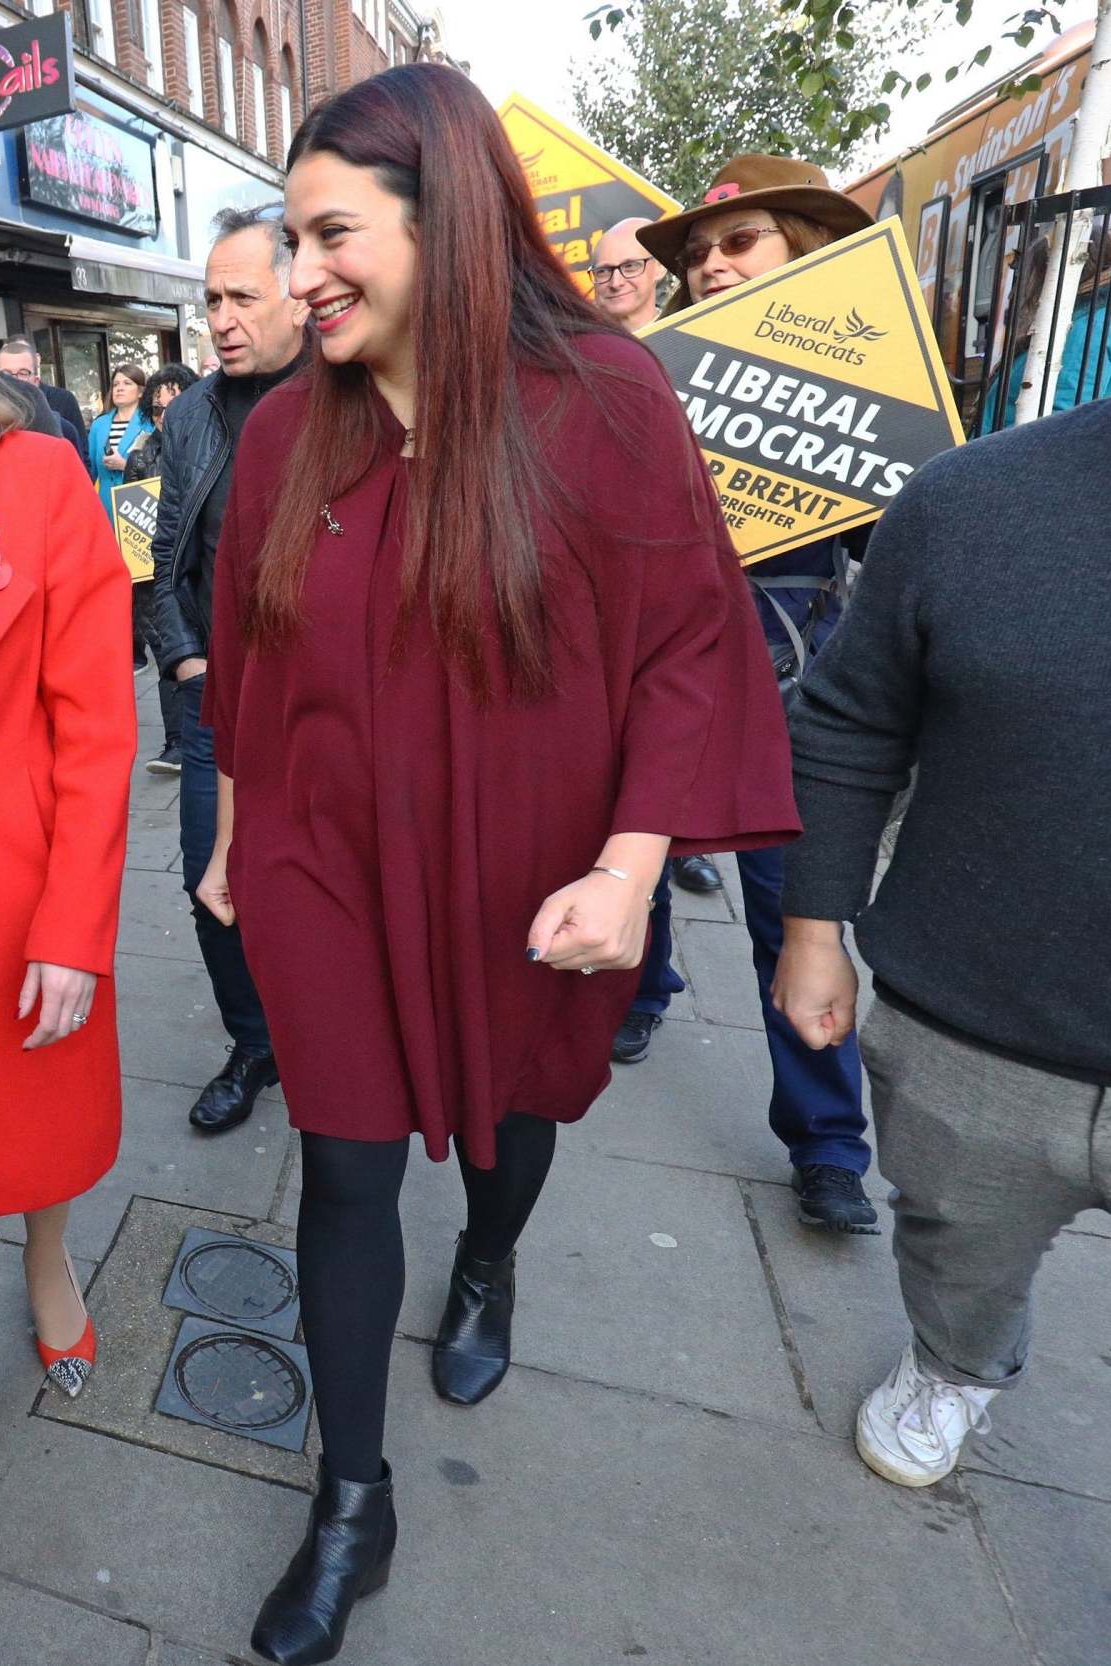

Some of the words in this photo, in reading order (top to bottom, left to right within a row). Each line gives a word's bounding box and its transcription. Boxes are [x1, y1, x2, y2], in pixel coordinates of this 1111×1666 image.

[537, 194, 582, 234] al
[764, 301, 836, 334] Liberal
[754, 320, 867, 366] Democrats
[689, 351, 882, 443] LIBERAL
[675, 390, 915, 497] MOCRATS
[719, 494, 796, 530] BRIGHTER
[727, 467, 843, 521] BREXIT
[122, 525, 147, 544] STOP
